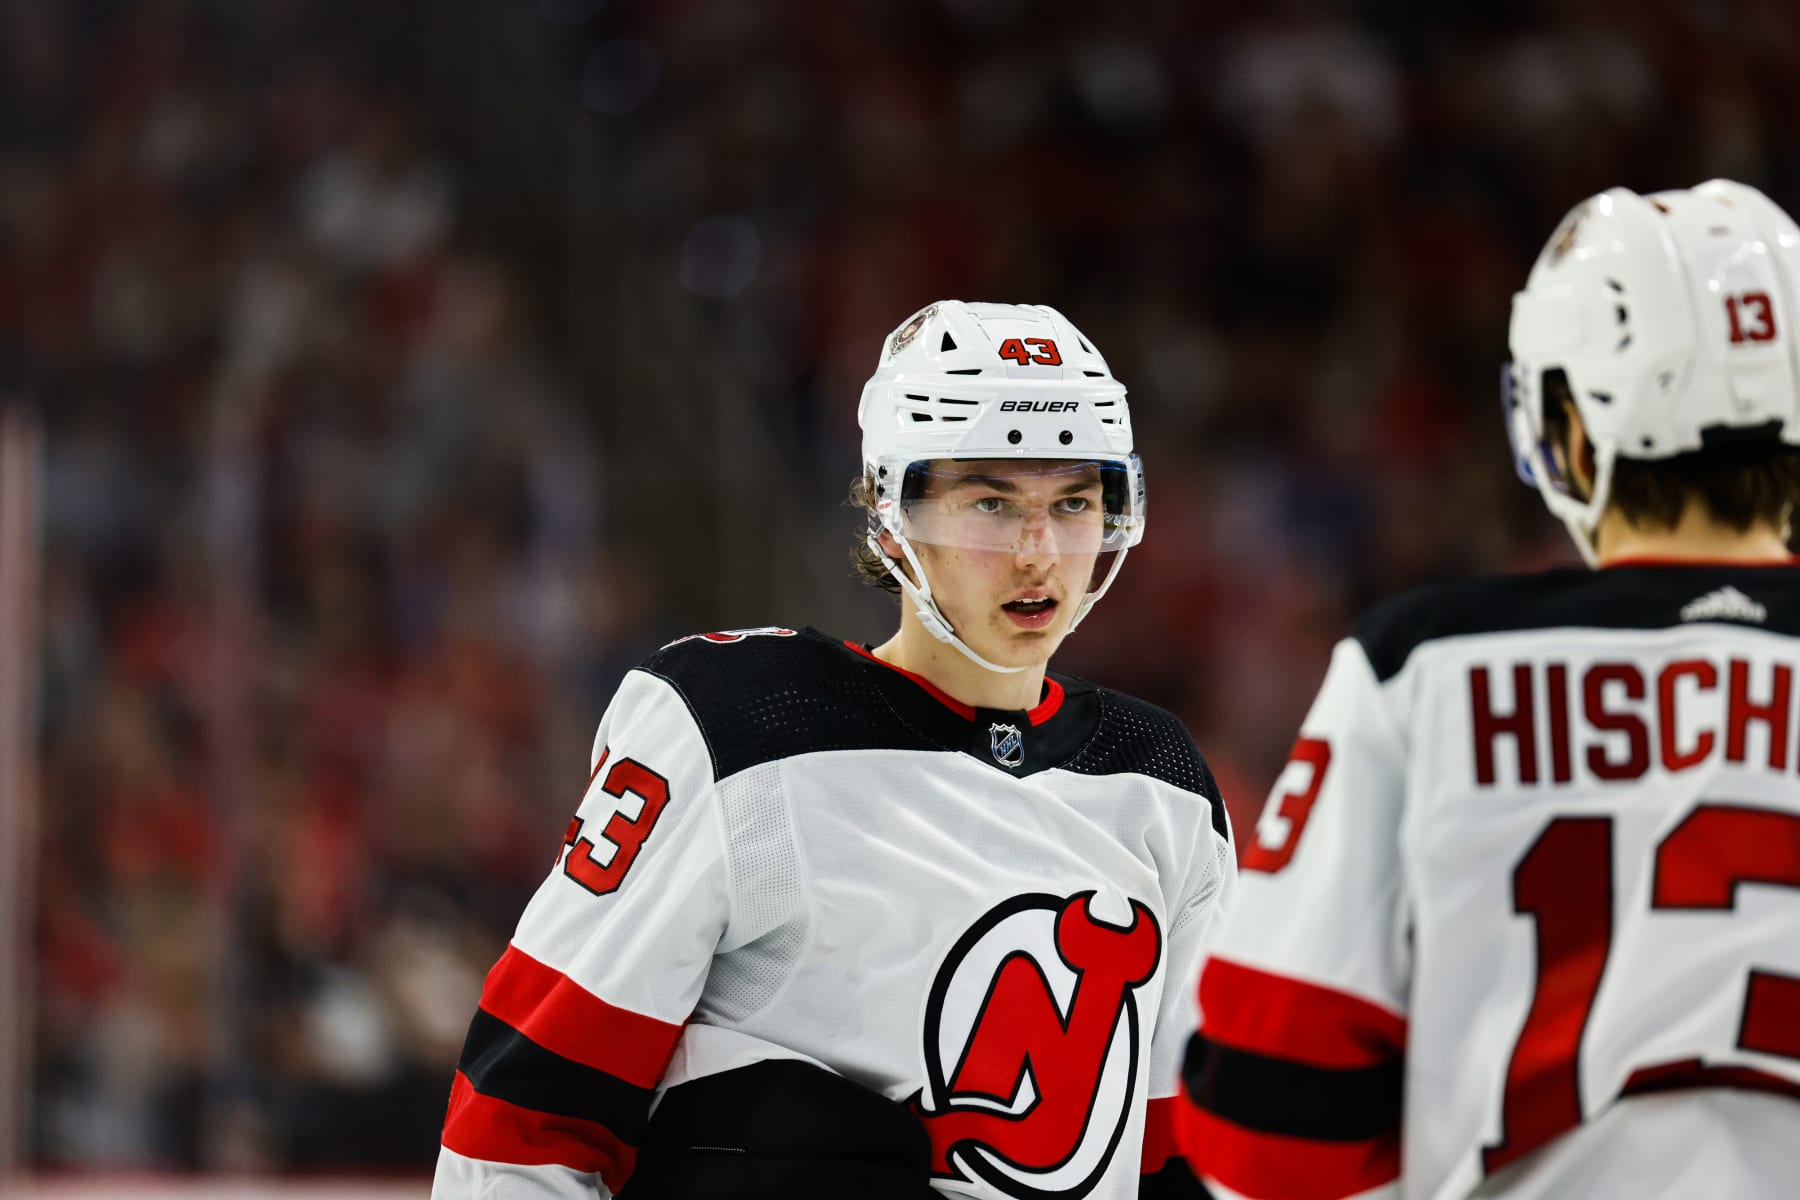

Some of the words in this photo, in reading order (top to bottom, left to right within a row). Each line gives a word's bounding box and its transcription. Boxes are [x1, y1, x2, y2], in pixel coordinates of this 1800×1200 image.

[1725, 292, 1776, 344] 13
[998, 337, 1064, 367] 43
[999, 400, 1079, 413] BAUER
[1468, 658, 1800, 787] HISCH
